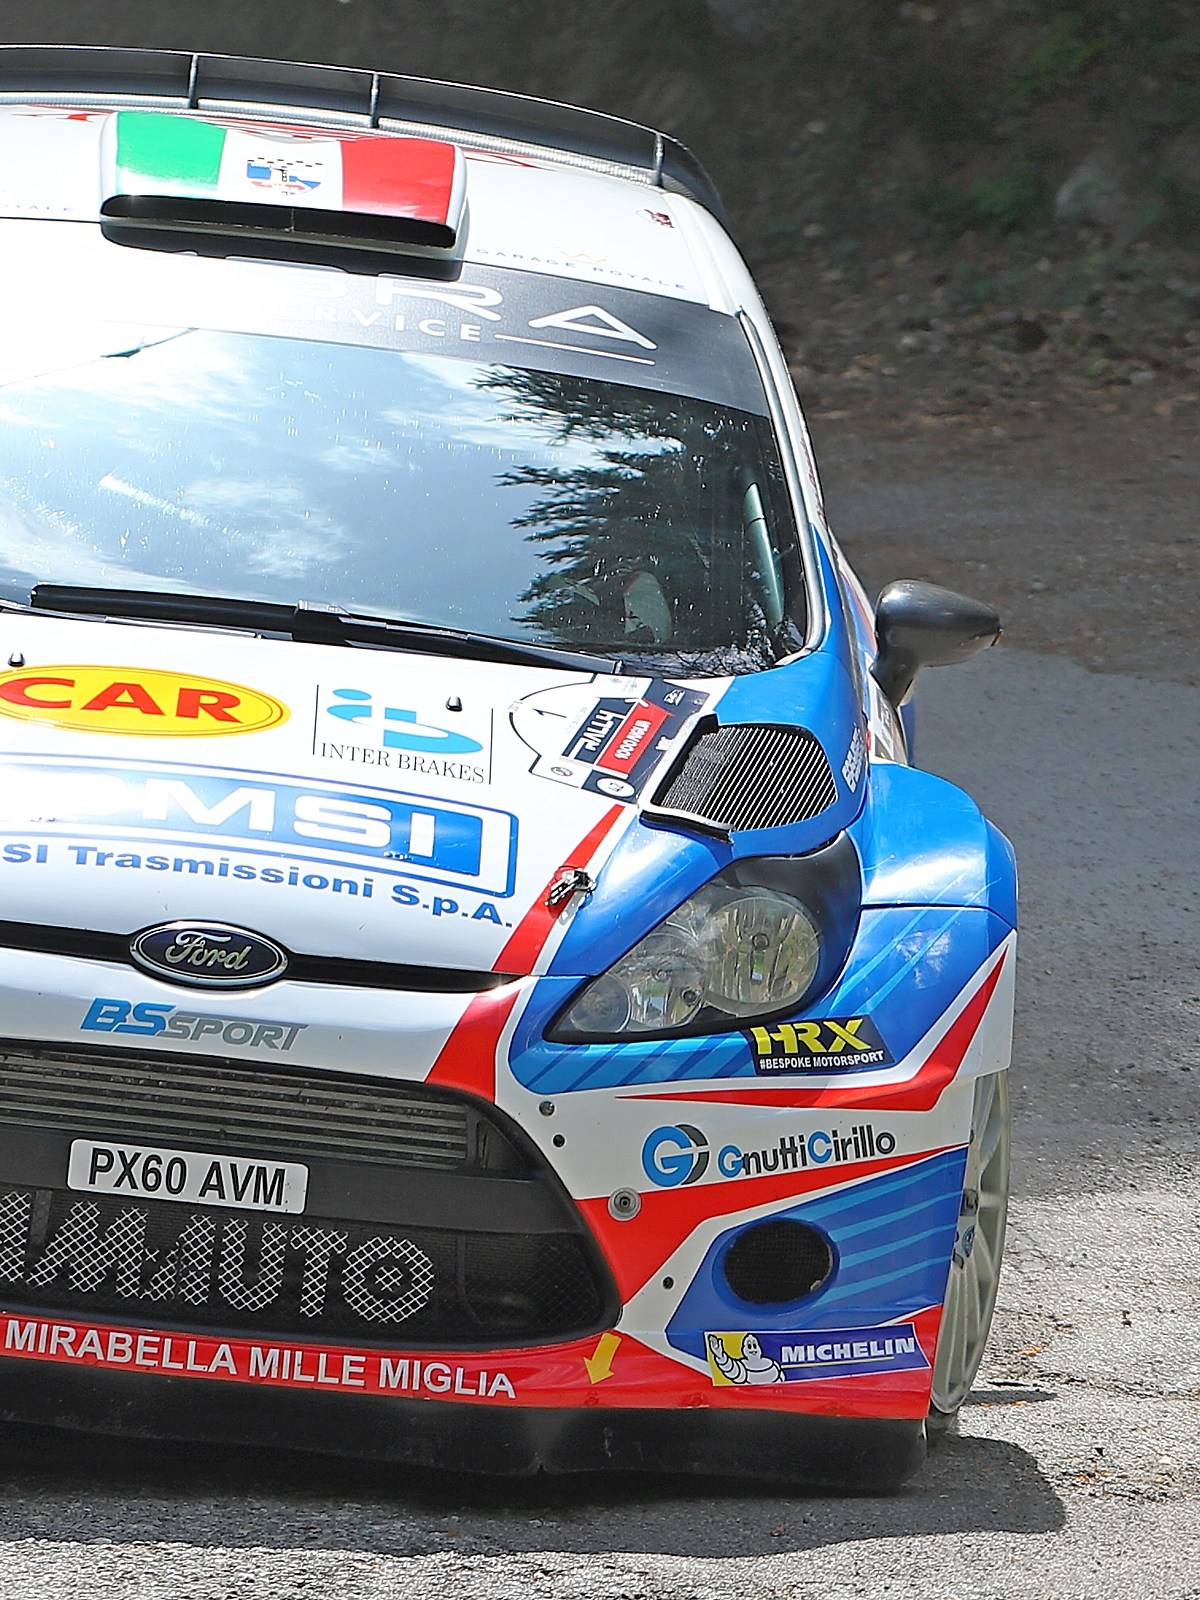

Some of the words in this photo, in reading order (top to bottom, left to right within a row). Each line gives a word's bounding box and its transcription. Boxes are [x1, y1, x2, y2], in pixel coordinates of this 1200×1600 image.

[476, 248, 577, 268] GARAGE
[592, 266, 687, 291] ROYALE
[320, 742, 391, 768] INTER
[397, 753, 485, 785] BRAKES
[68, 844, 374, 899] Trasmissioni
[390, 884, 514, 928] S.p.A.
[164, 929, 254, 972] Ford
[749, 1018, 873, 1056] HRX
[759, 1055, 812, 1071] #BESPOKE
[812, 1050, 886, 1069] MOTORSPORT
[88, 1148, 188, 1196] PX60
[198, 1156, 287, 1206] AVM
[4, 1320, 238, 1377] MIRABELLA
[247, 1347, 367, 1387] MILLE
[379, 1357, 518, 1399] MIGLIA
[780, 1336, 916, 1364] MICHELIN
